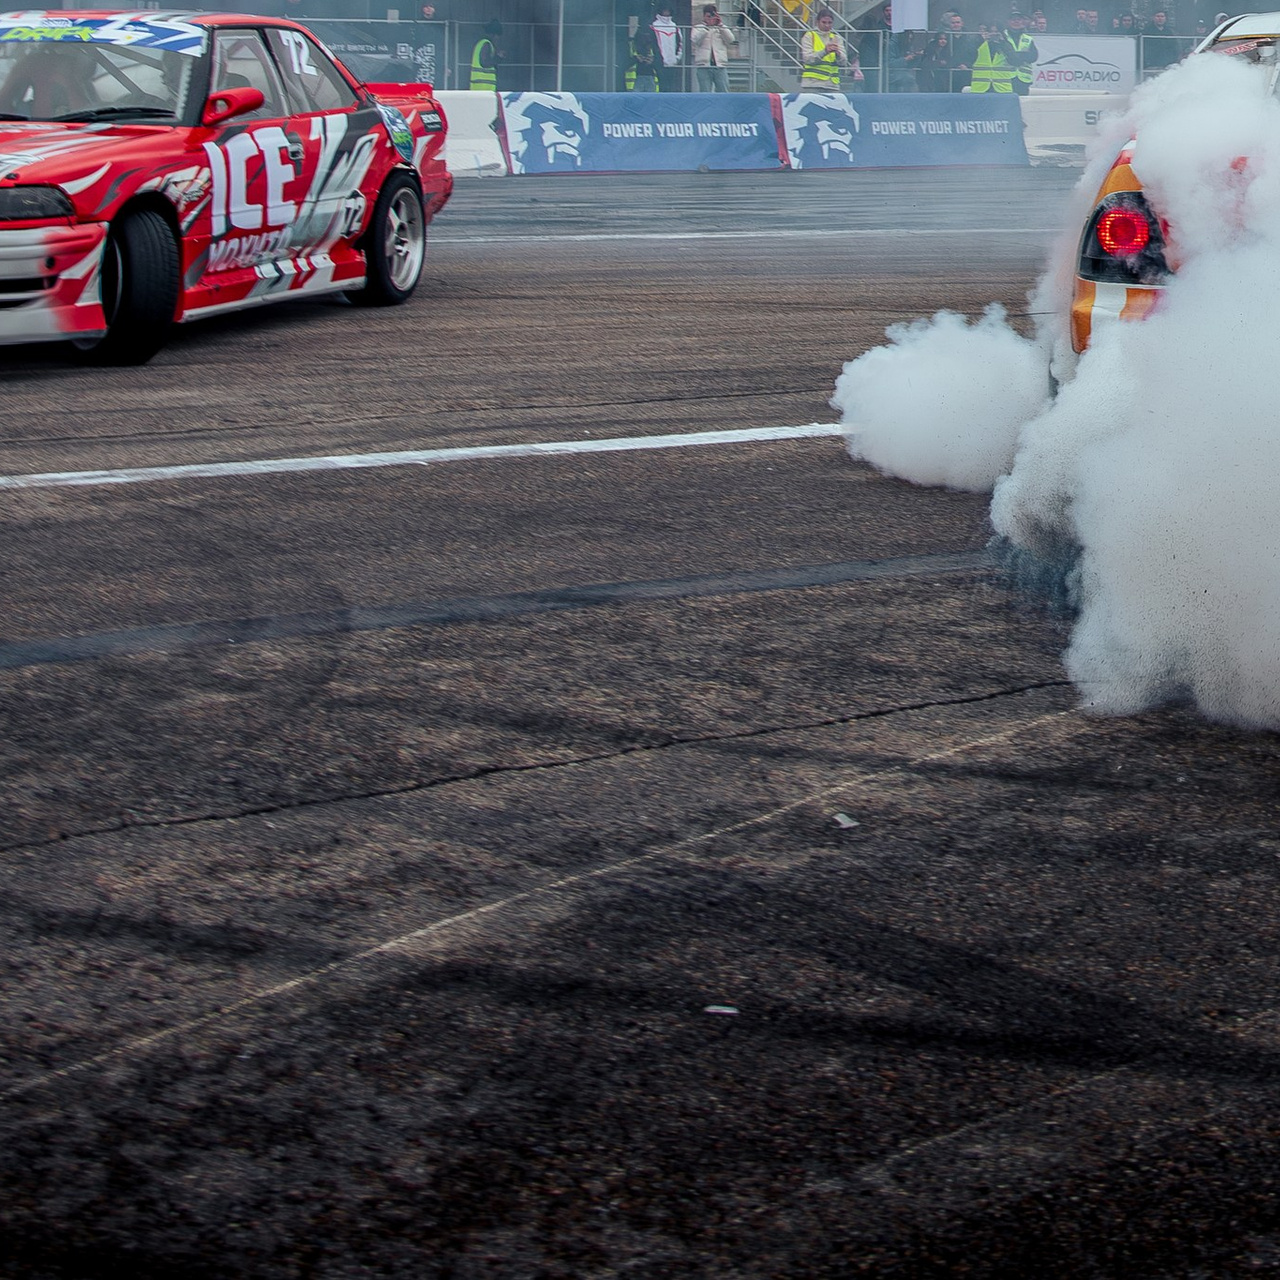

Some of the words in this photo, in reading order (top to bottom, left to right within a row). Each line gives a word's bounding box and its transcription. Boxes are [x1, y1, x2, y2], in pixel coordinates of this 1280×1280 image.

[280, 28, 320, 77] 72
[1035, 69, 1122, 83] АВТОРАДИО
[603, 123, 652, 138] POWER
[656, 122, 694, 138] YOUR
[698, 122, 758, 138] INSTINCT
[871, 120, 916, 135] POWER
[919, 120, 953, 135] YOUR
[956, 120, 1009, 135] INSTINCT
[203, 126, 297, 236] ICE
